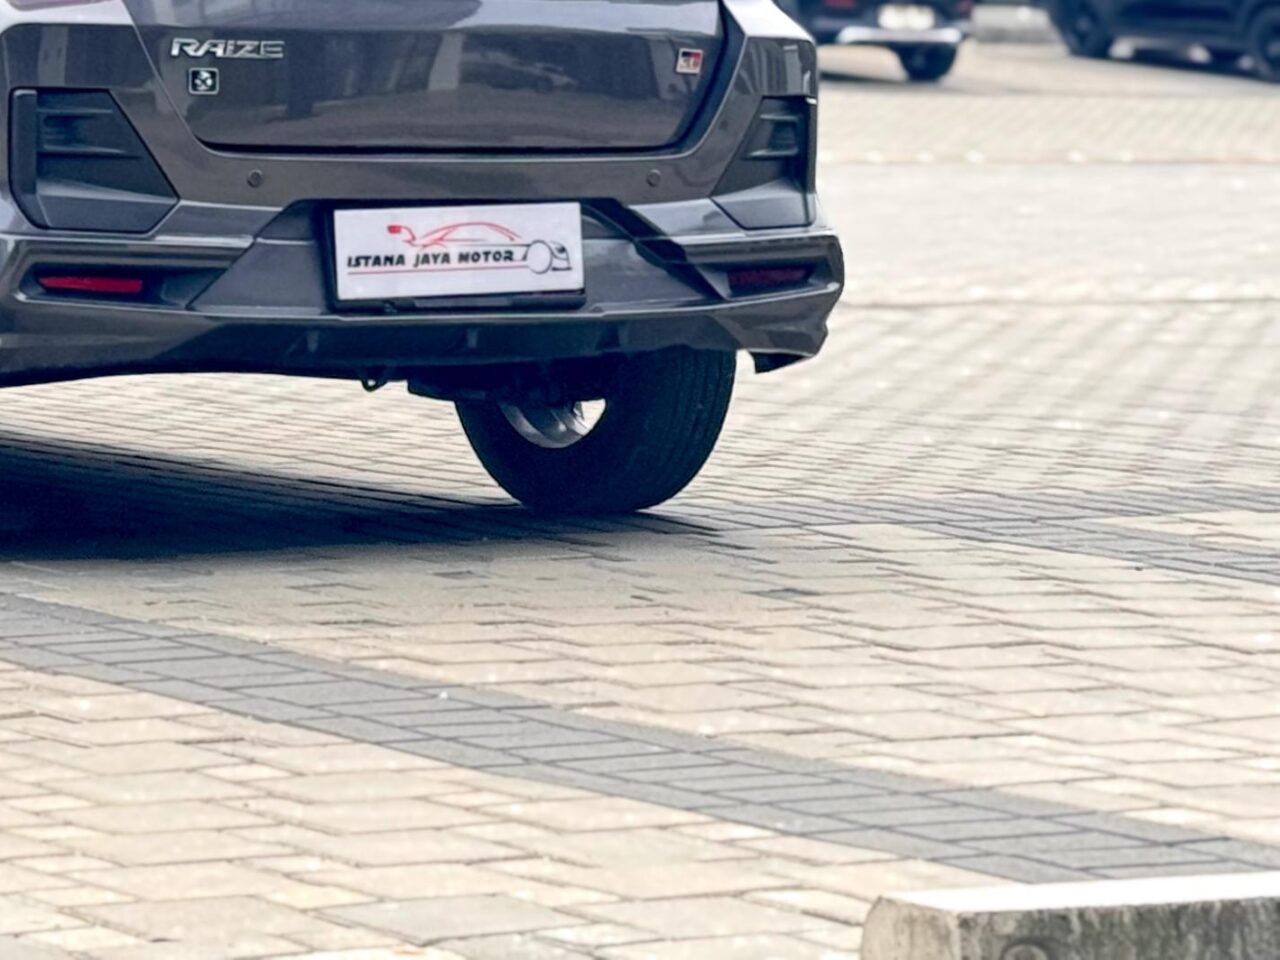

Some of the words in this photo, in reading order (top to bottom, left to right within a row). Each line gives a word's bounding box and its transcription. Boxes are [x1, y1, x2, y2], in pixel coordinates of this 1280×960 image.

[170, 37, 286, 60] RAIZE
[346, 254, 406, 269] ISTANA
[413, 252, 451, 269] JAYA
[457, 249, 514, 265] MOTOR
